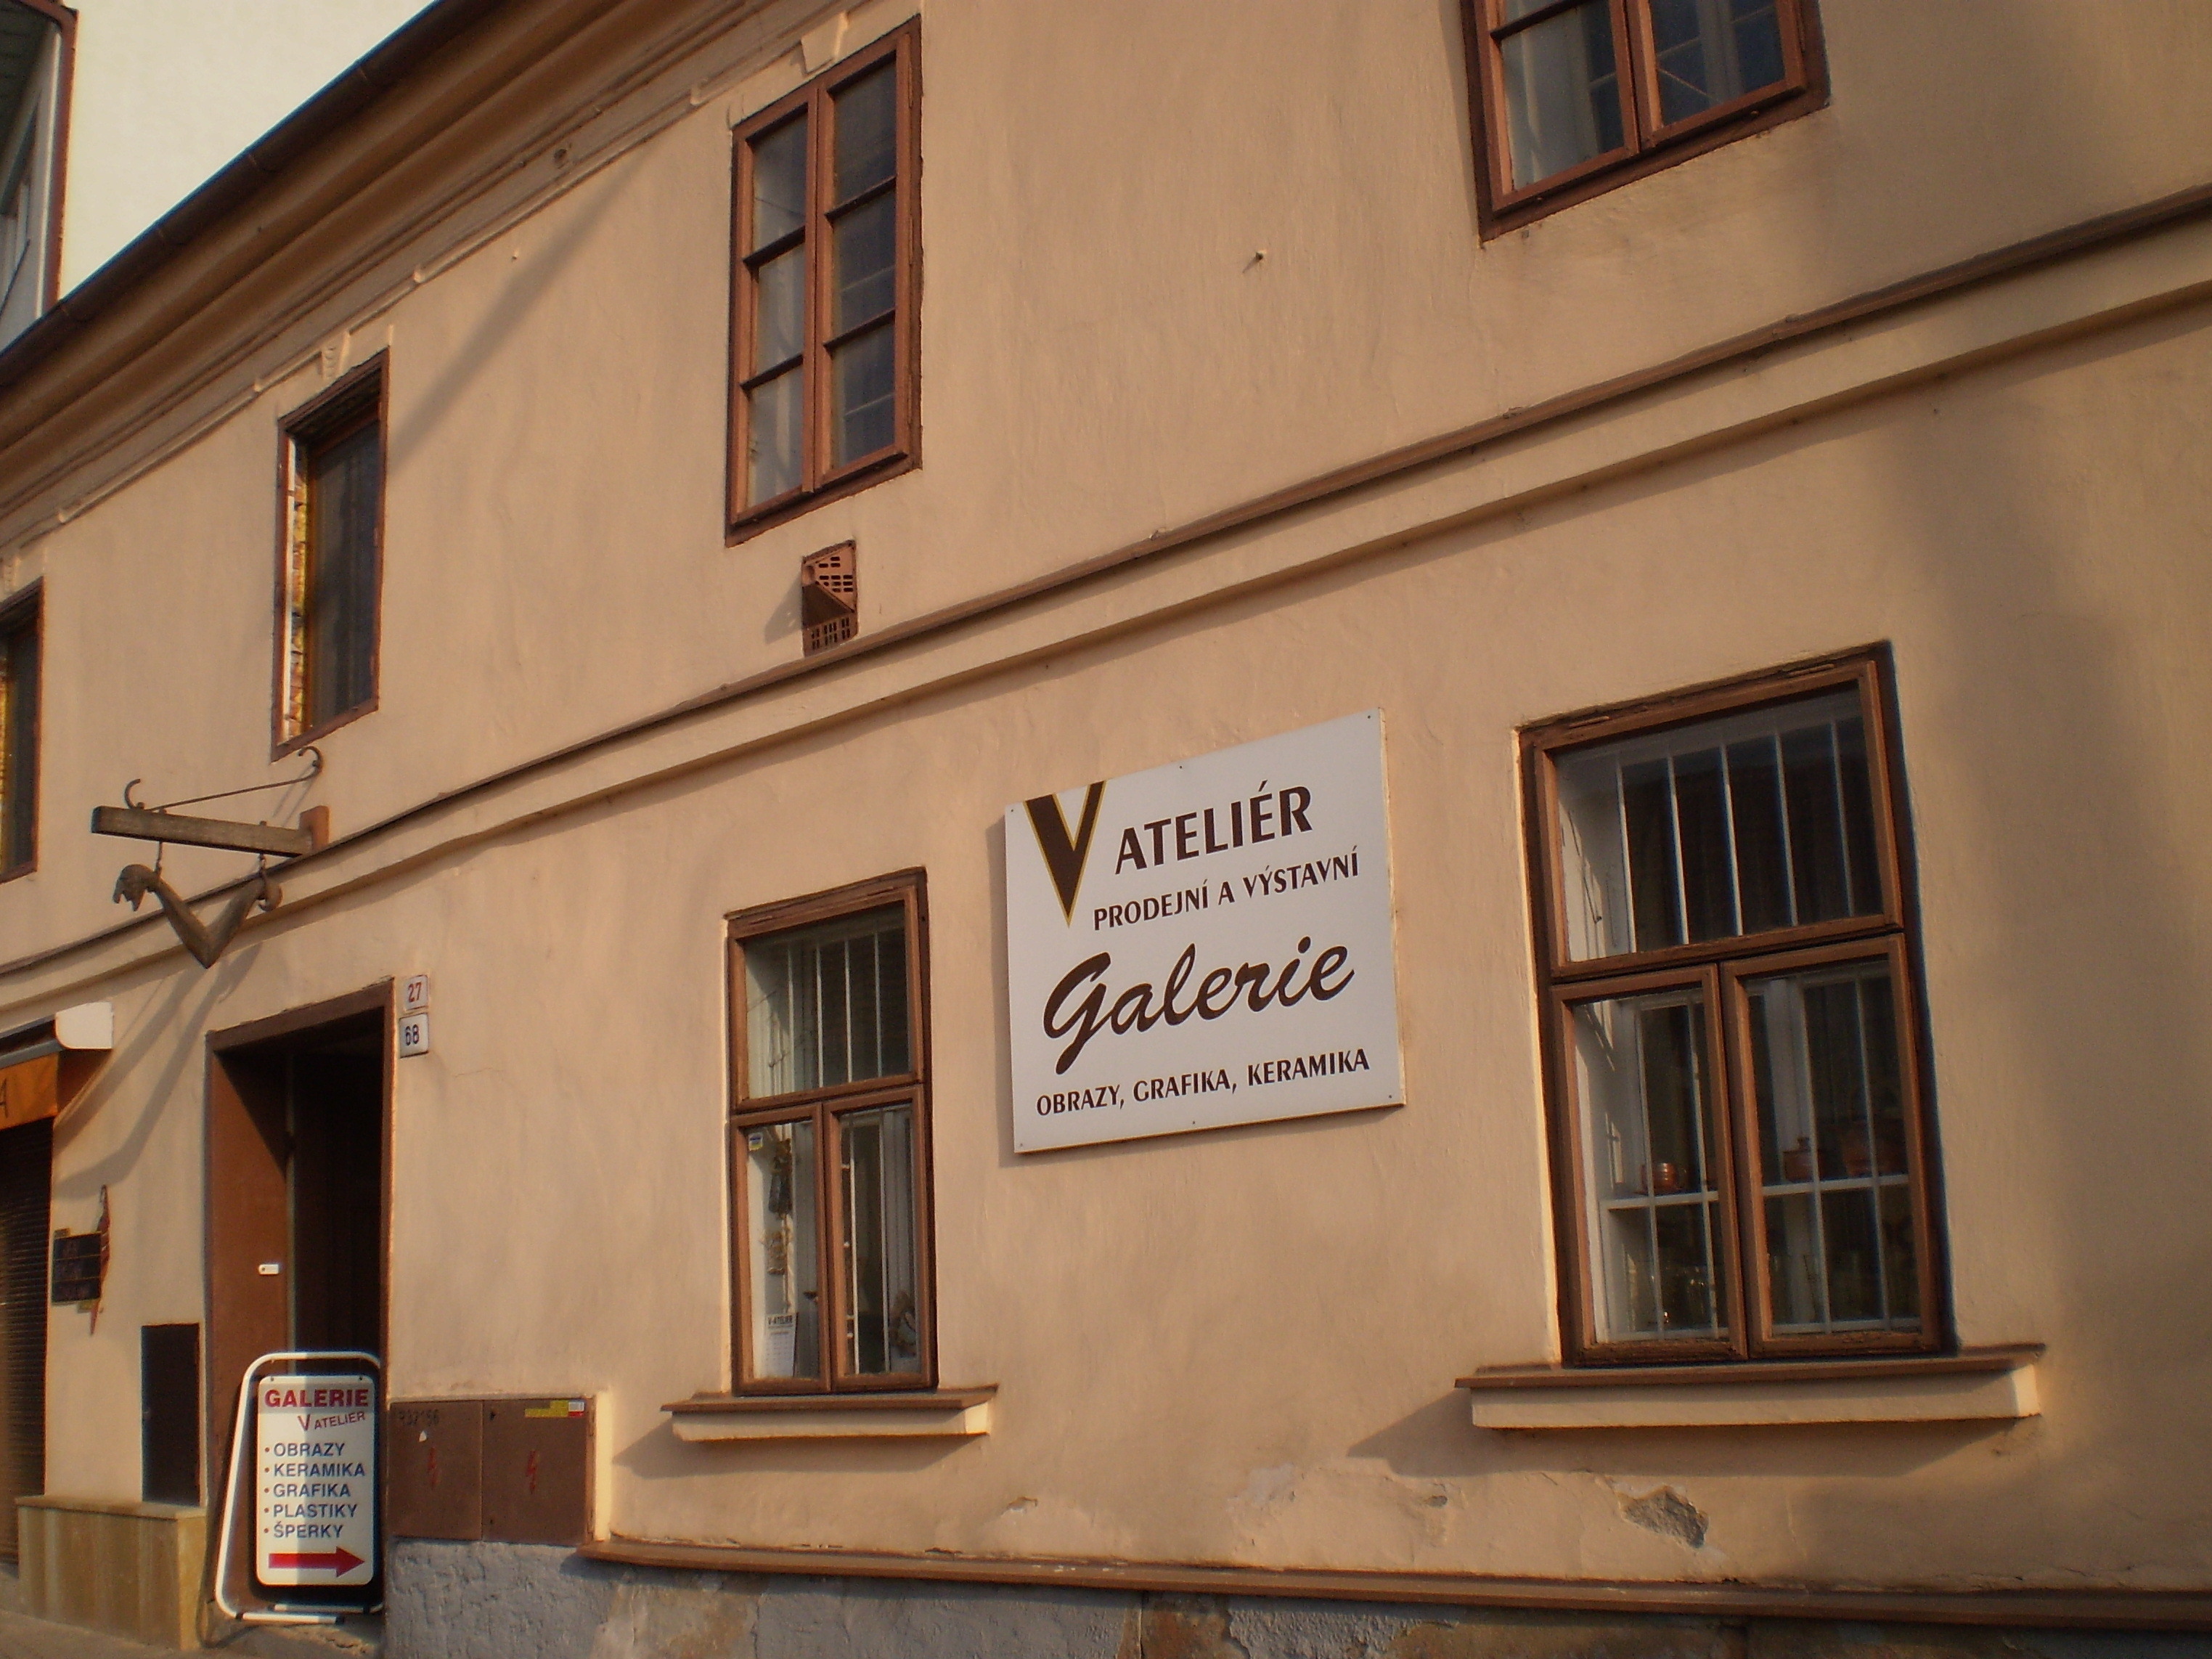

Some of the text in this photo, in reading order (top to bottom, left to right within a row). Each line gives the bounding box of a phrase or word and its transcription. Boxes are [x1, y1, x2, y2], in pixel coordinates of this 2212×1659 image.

[1023, 780, 1313, 929] V ATELIÉR
[1093, 845, 1359, 931] PRODEJNÍ A VÝSTAVNÍ
[408, 982, 422, 1003] 27
[1042, 936, 1355, 1075] Galerie
[405, 1024, 420, 1046] 68
[1036, 1048, 1370, 1117] OBRAZY, GRAFIKA, KERAMIKA
[264, 1388, 369, 1408] GALERIE
[297, 1411, 365, 1432] V ATELIER
[274, 1442, 346, 1457] OBRAZY
[274, 1462, 365, 1477] KERAMIKA
[273, 1483, 351, 1497] GRAFIKA
[273, 1504, 358, 1518] PLASTIKY
